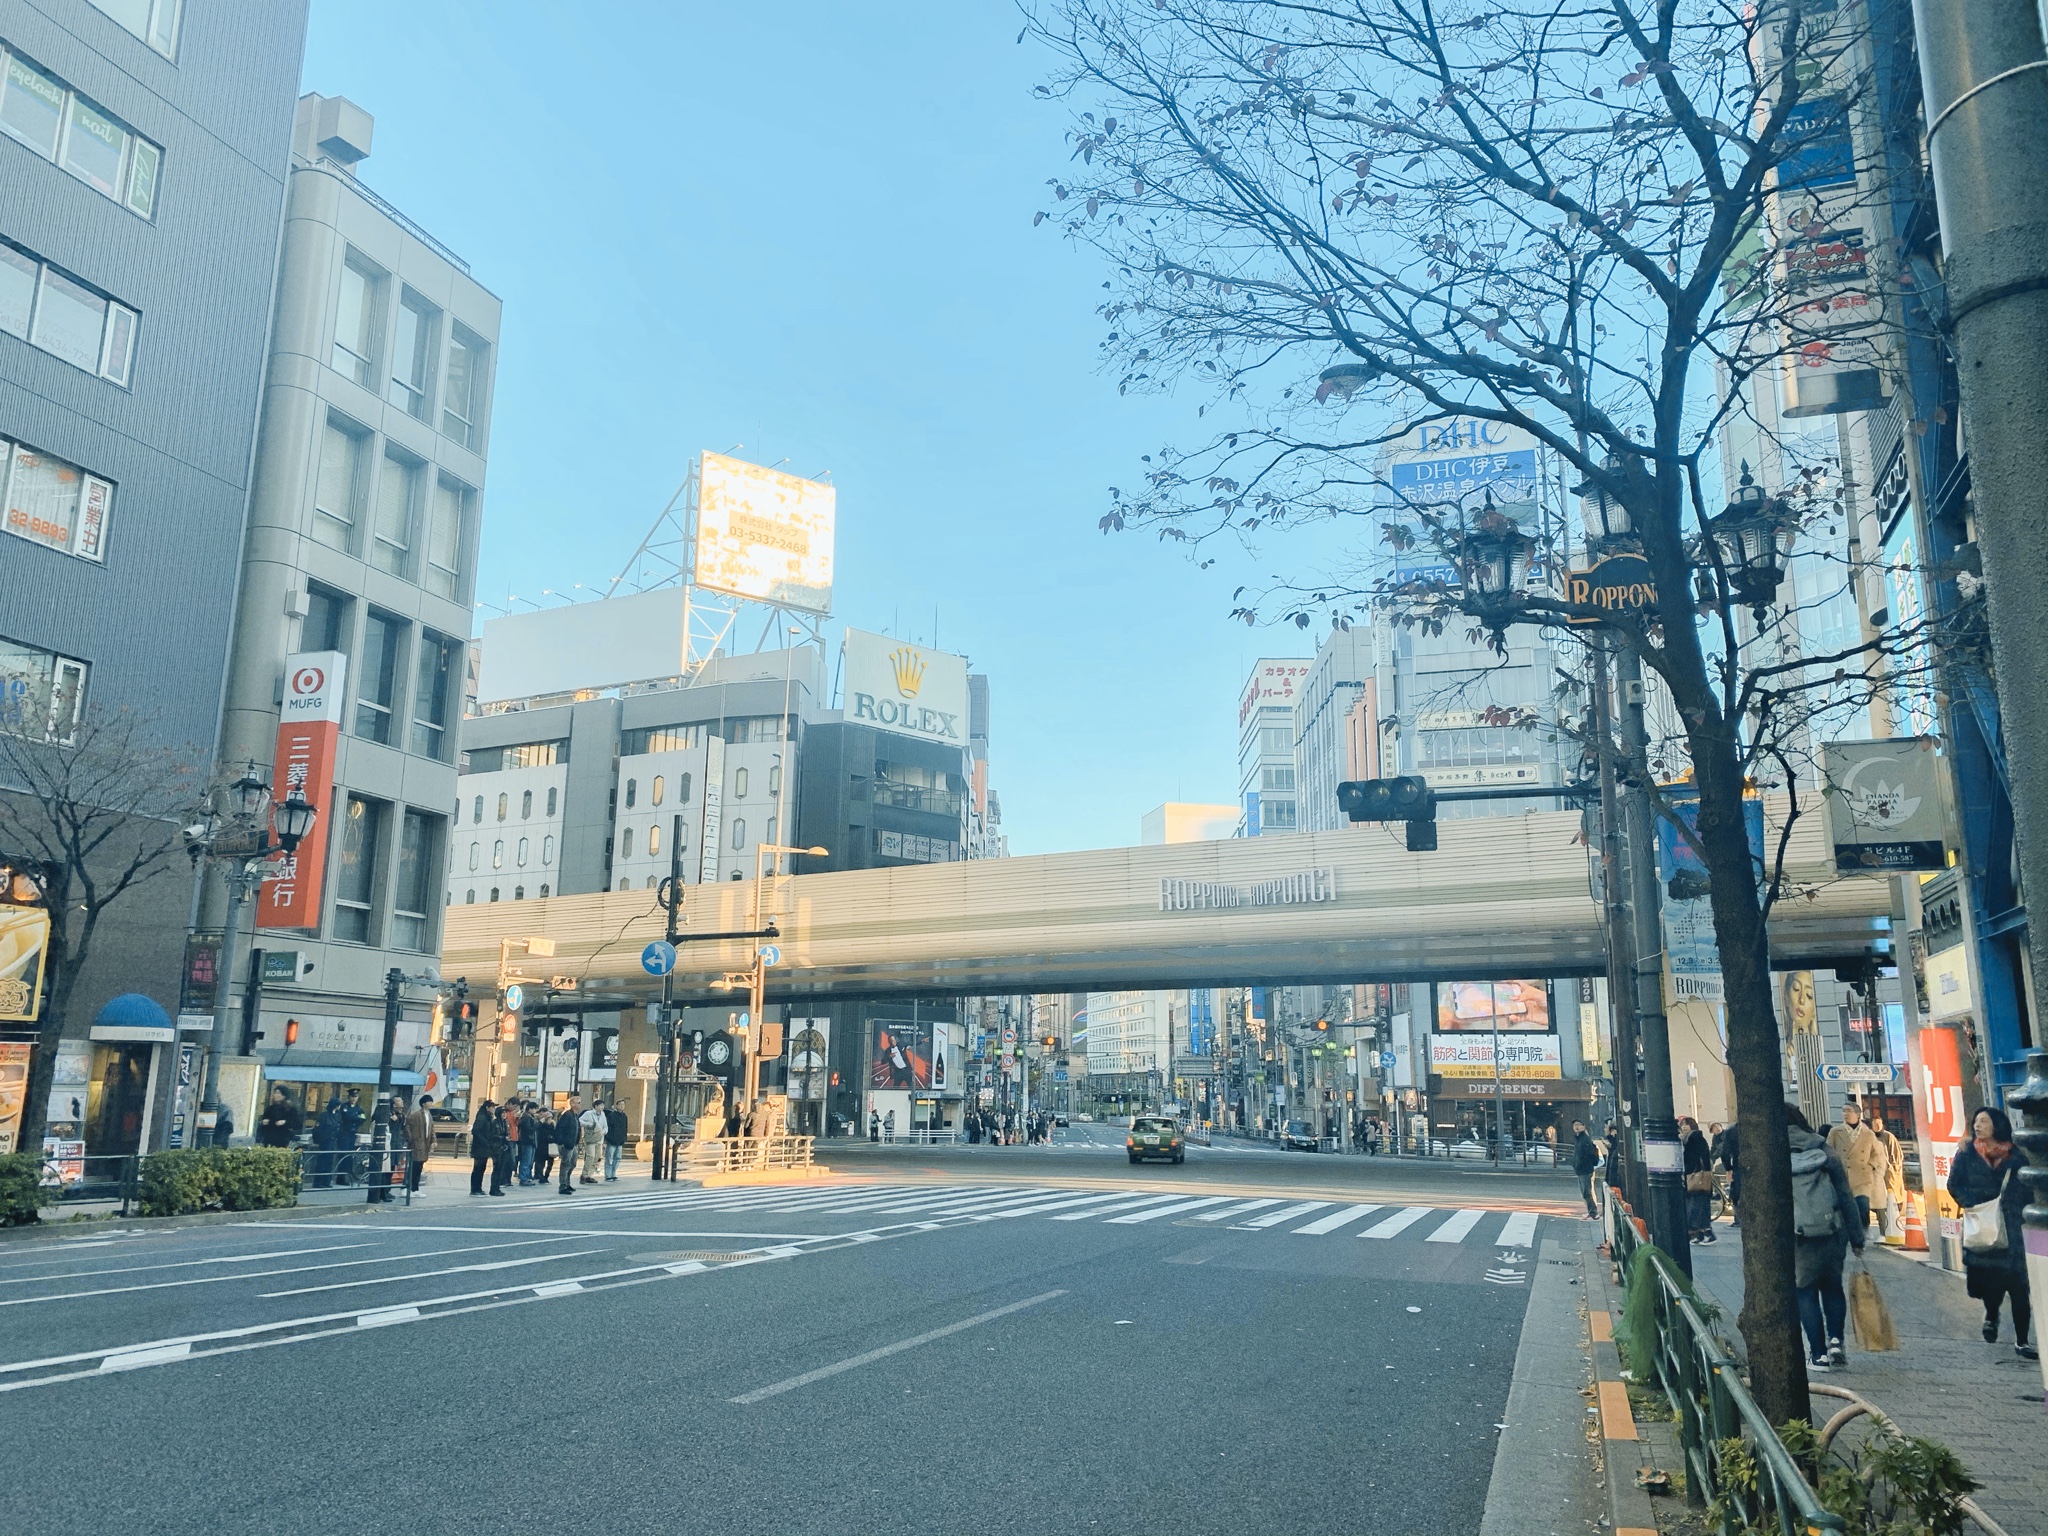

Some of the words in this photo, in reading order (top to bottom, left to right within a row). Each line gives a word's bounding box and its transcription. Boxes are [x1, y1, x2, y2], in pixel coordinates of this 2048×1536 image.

[10, 64, 60, 105] eyelash
[82, 115, 113, 143] nail
[1839, 346, 1870, 355] Tax-free
[1843, 338, 1867, 347] Japan
[1419, 418, 1508, 453] DHC
[1416, 455, 1512, 481] DHC伊豆
[729, 526, 807, 555] 03-5337-2468
[1571, 580, 1657, 610] ROPPON
[1266, 667, 1309, 676] カラオケ
[1282, 678, 1292, 687] &
[289, 697, 322, 710] MUFG
[854, 692, 959, 738] ROLEX
[1158, 877, 1240, 911] ROPPONGI
[1250, 864, 1337, 906] ROPPONGI
[265, 969, 294, 977] KOBAN
[1433, 1046, 1543, 1061] 筋肉と関節の専門院
[1842, 1066, 1888, 1075] 六本木通り
